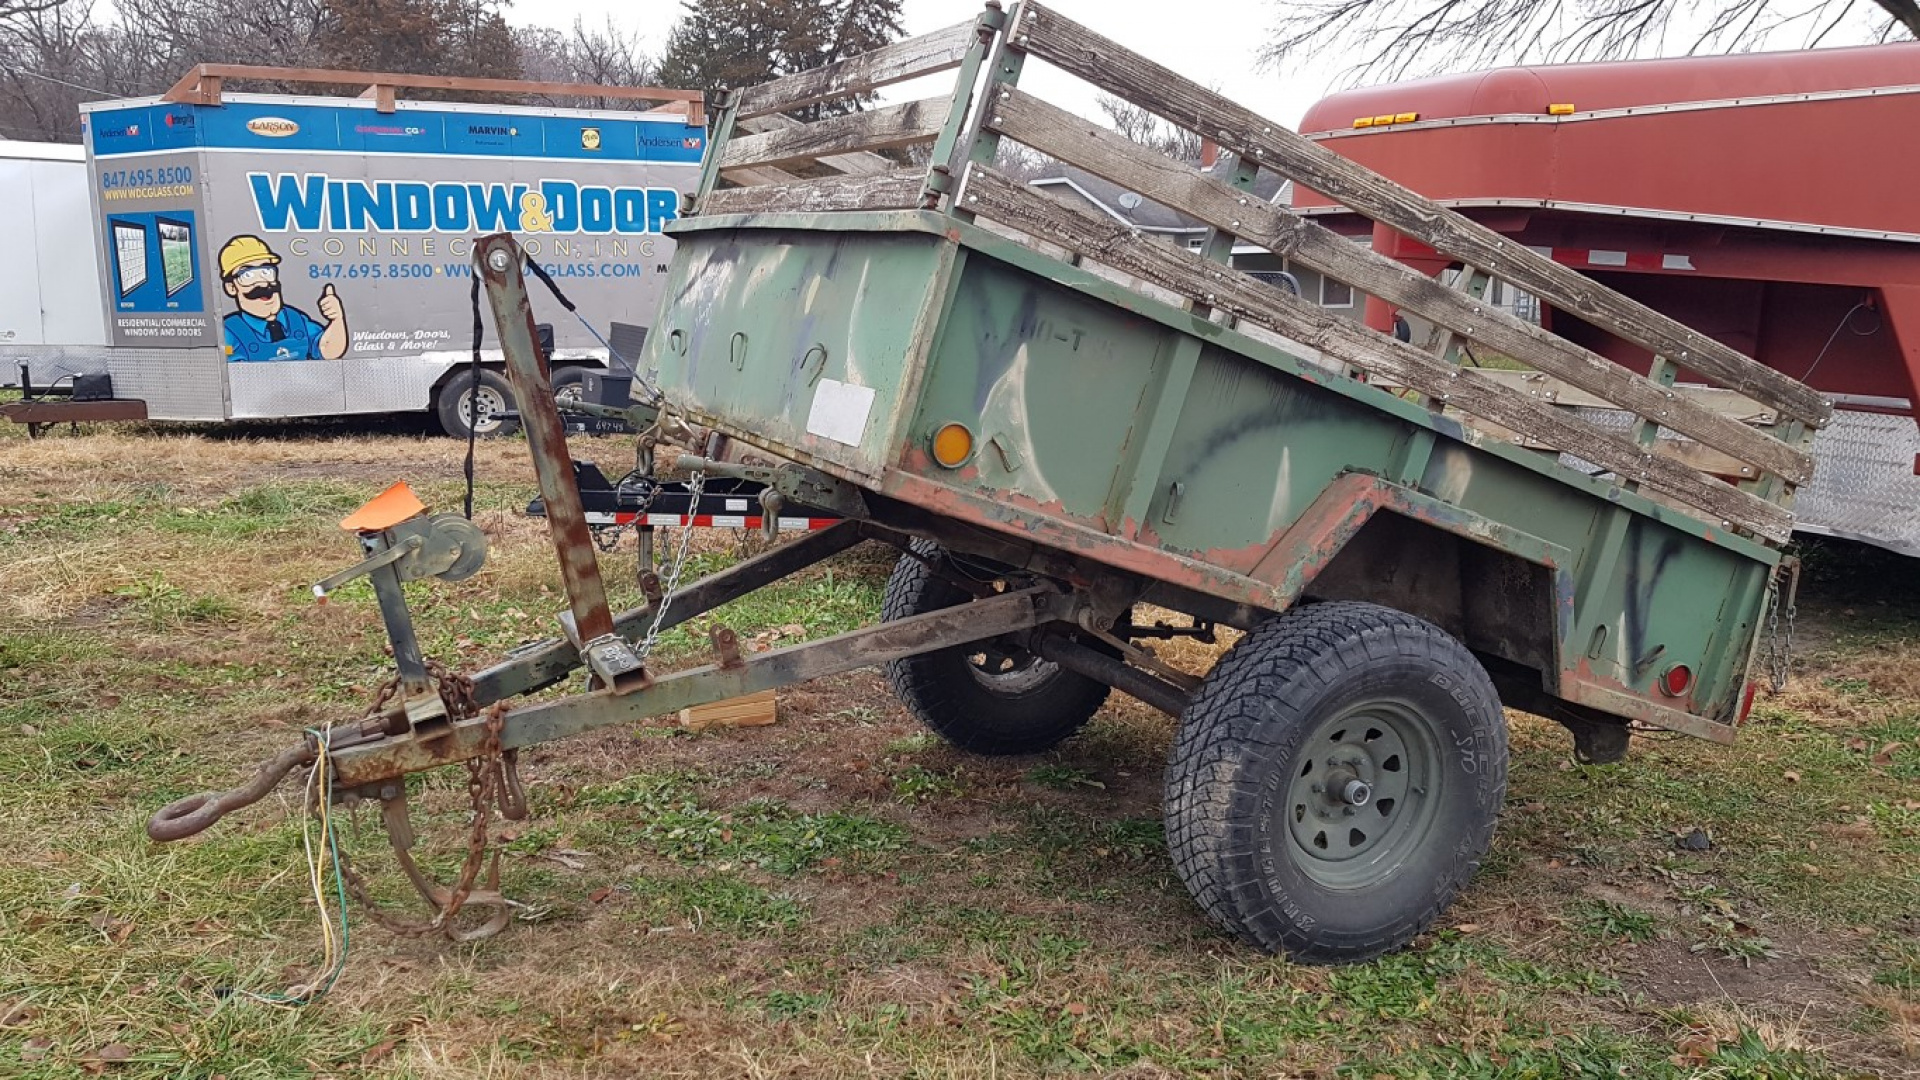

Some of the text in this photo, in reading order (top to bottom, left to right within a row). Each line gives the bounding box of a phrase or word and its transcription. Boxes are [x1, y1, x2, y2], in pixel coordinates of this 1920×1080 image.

[251, 122, 295, 133] LARSON
[468, 125, 508, 136] MARVIN
[638, 135, 682, 147] Andersen
[103, 166, 192, 189] 847.695.8500
[308, 263, 433, 279] 847.695.8500
[123, 328, 202, 337] WINDOWS AND DOORS
[413, 329, 451, 341] Doors,
[353, 340, 438, 352] Glass & More!
